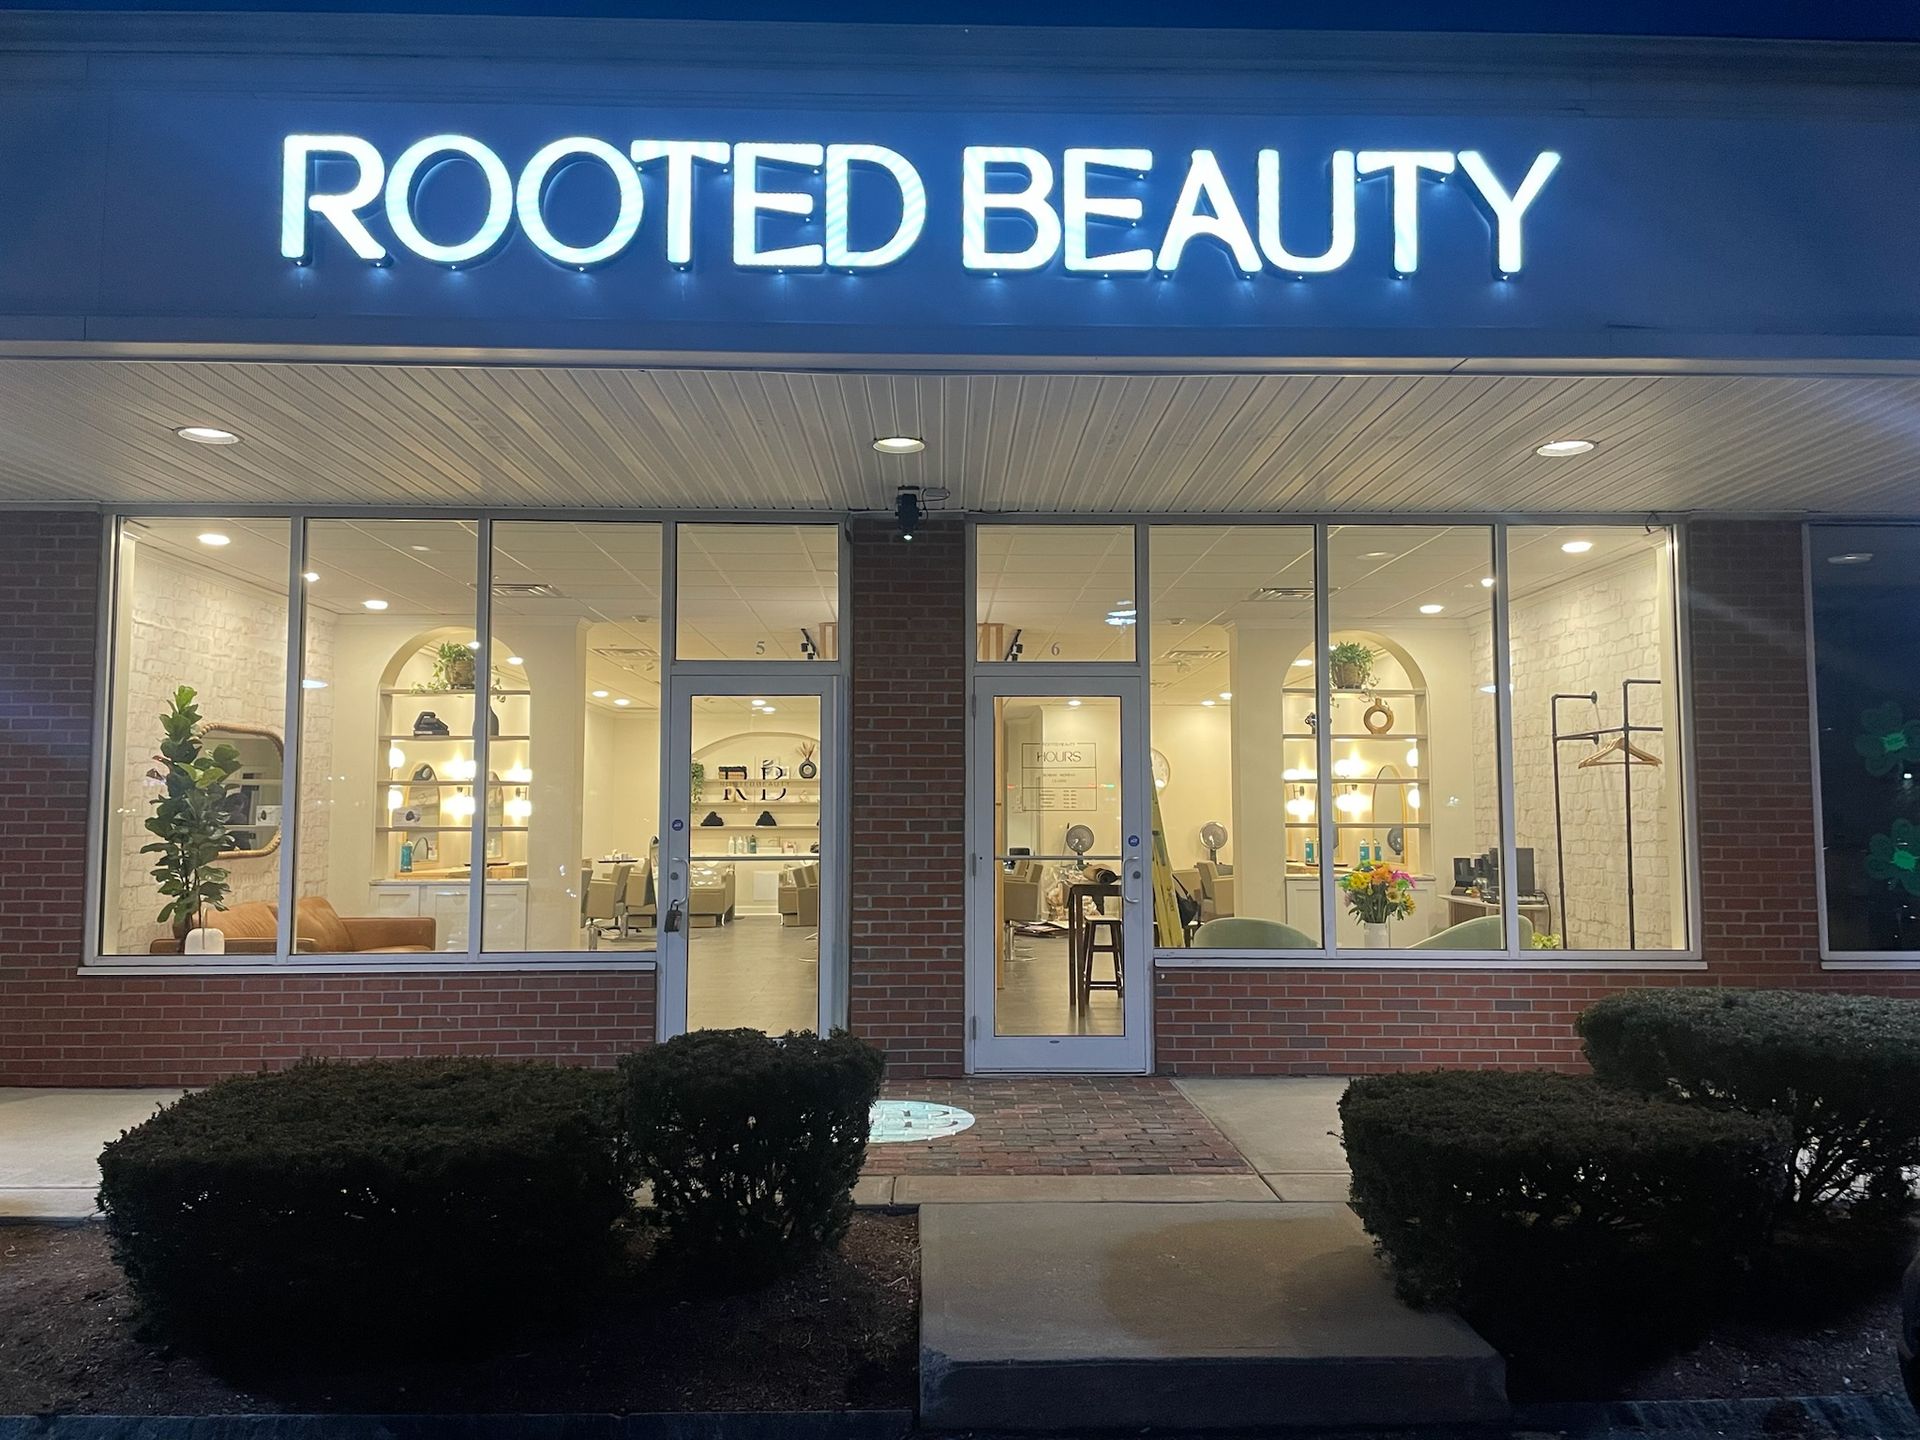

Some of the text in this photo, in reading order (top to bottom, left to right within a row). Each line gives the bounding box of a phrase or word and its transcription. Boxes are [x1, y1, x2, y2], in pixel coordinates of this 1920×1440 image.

[281, 134, 1561, 273] ROOTED BEAUTY
[755, 641, 765, 655] 5
[1051, 641, 1060, 656] 6
[1036, 751, 1082, 763] HOURS
